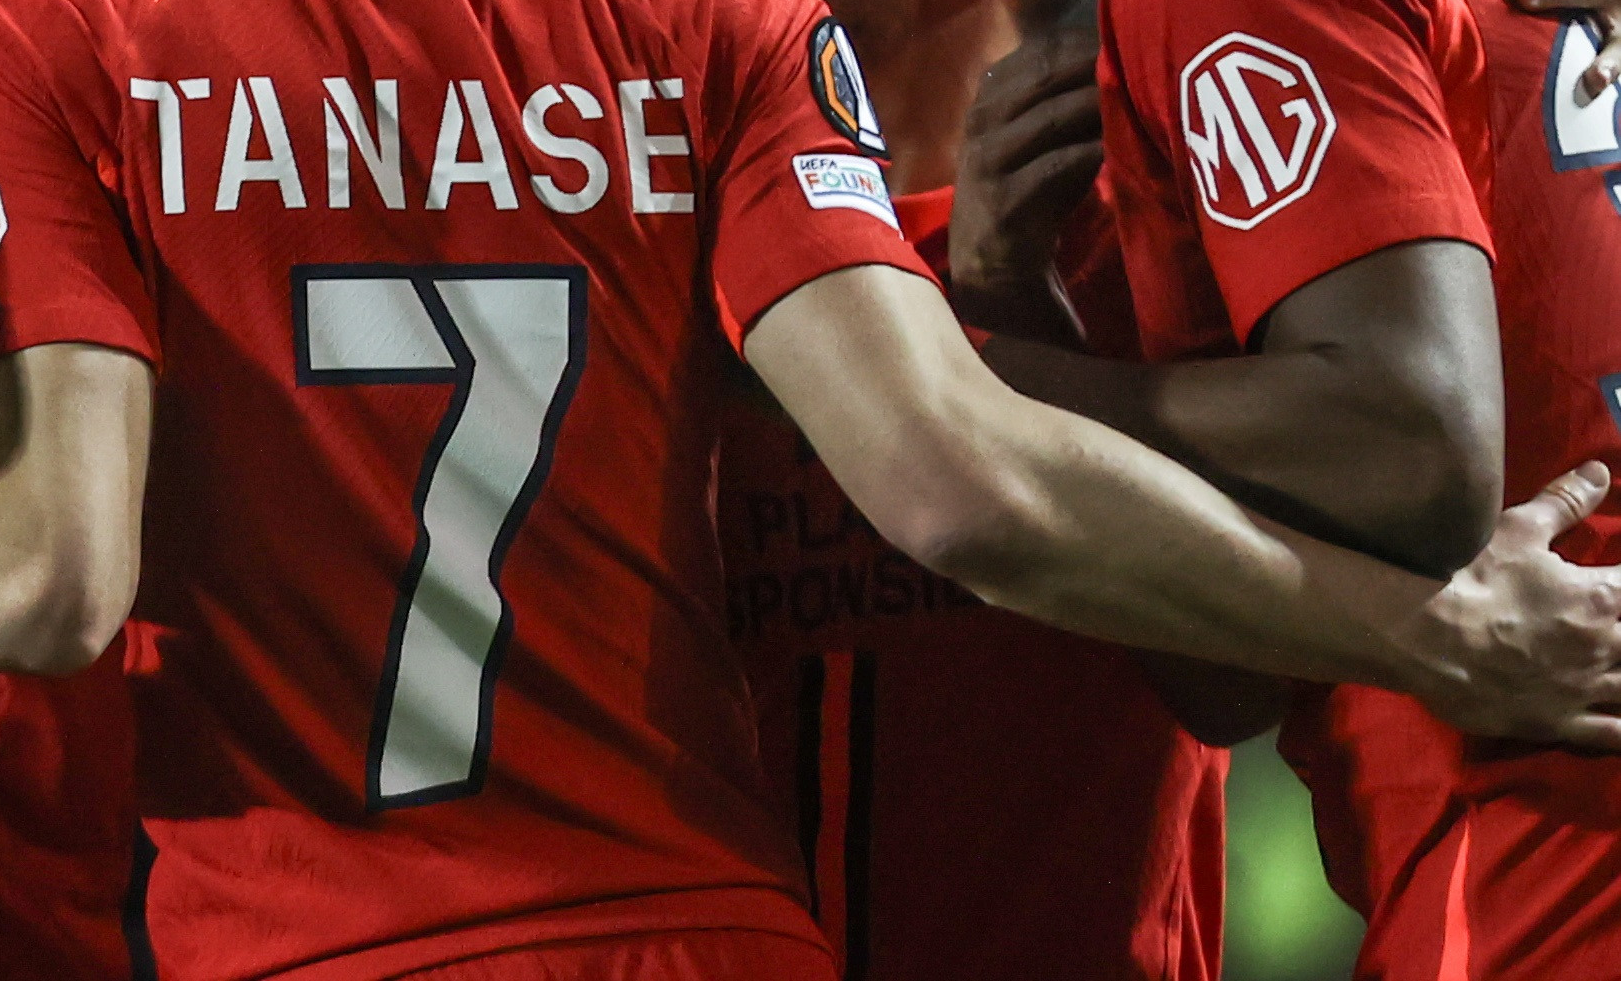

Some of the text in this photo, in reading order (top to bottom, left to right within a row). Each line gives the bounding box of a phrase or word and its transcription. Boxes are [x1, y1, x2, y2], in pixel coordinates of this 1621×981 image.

[130, 75, 695, 216] TANASE
[799, 157, 838, 171] UEFA
[1187, 49, 1320, 209] MG
[291, 261, 587, 812] 7
